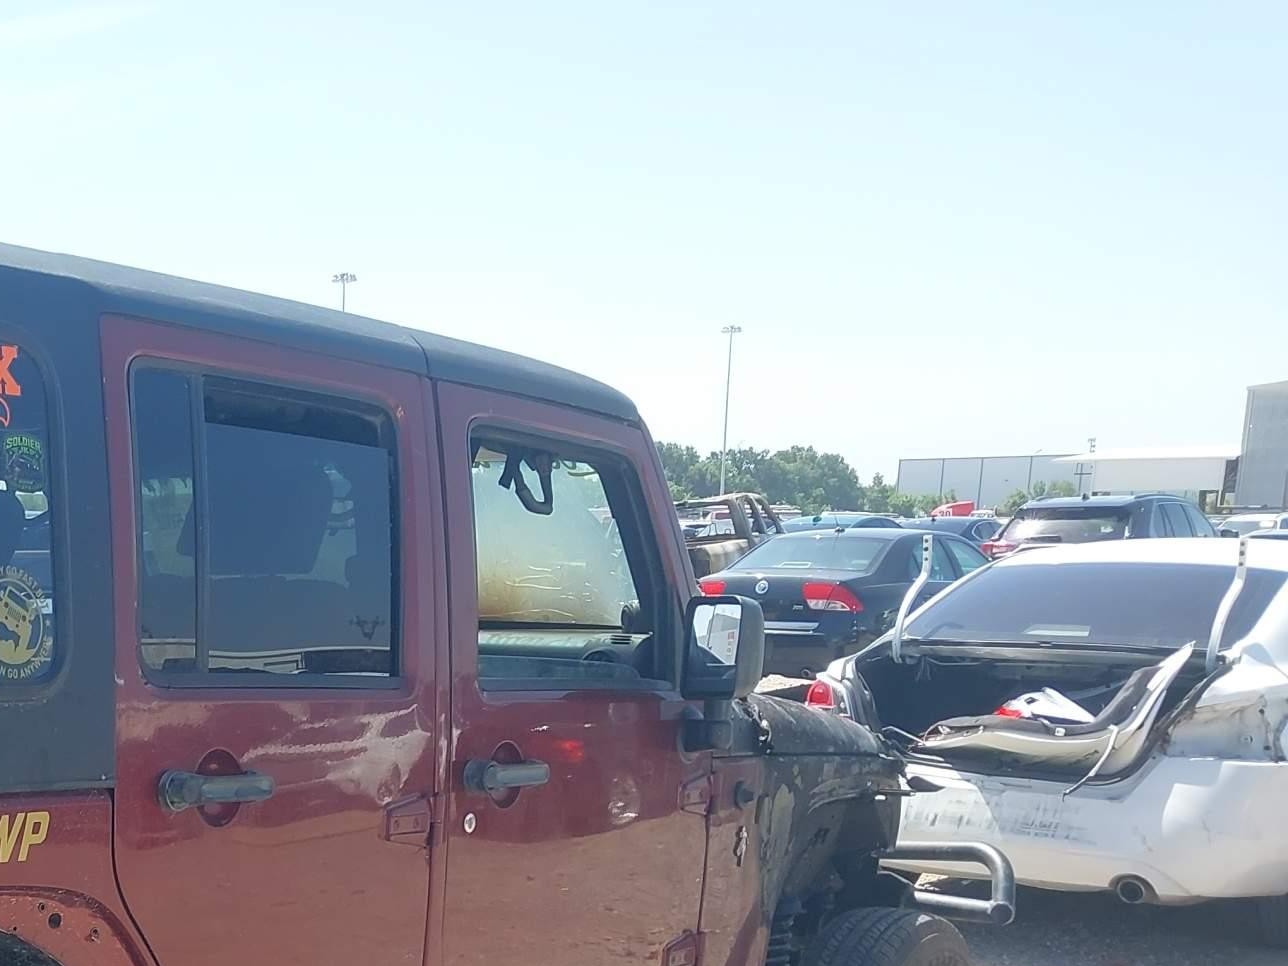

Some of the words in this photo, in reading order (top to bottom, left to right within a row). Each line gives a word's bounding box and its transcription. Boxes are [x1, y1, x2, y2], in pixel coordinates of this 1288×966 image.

[6, 565, 17, 577] GO
[18, 569, 38, 588] FAST
[7, 668, 18, 679] GO
